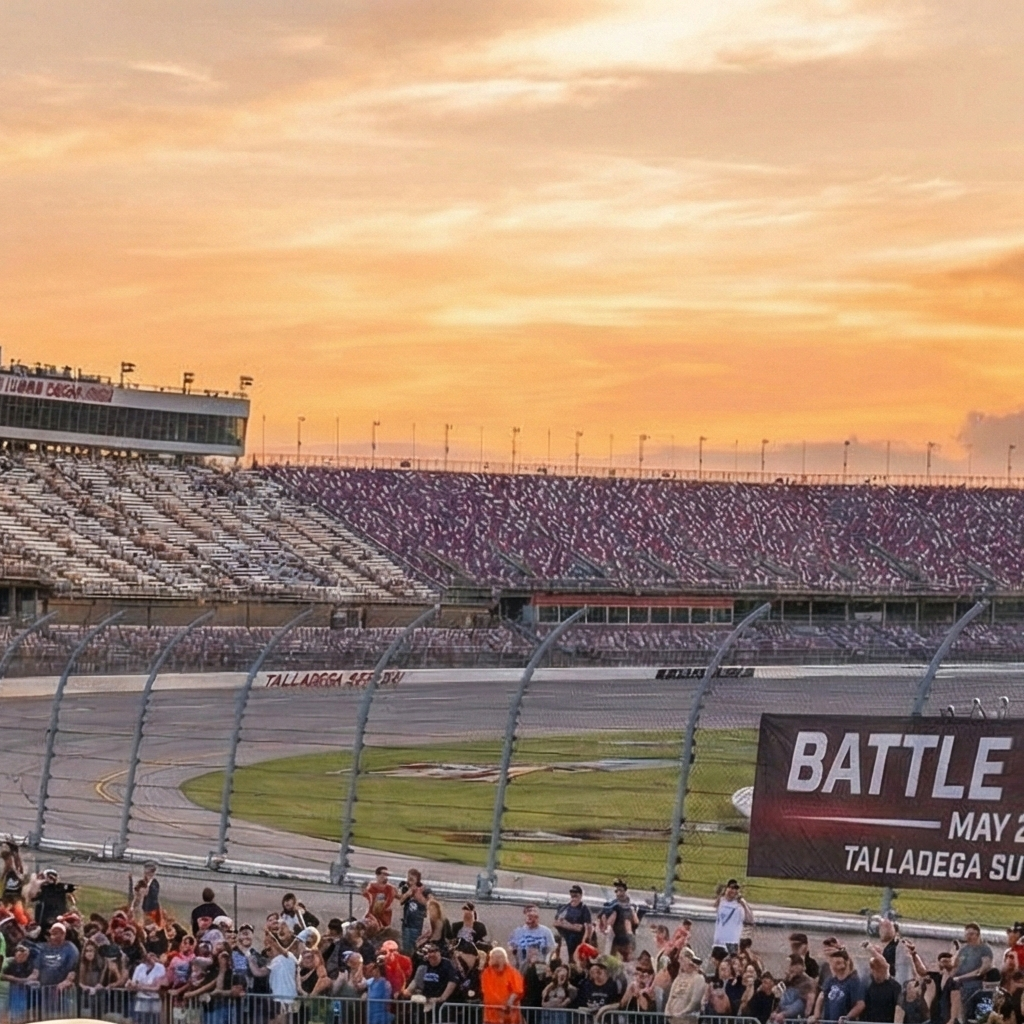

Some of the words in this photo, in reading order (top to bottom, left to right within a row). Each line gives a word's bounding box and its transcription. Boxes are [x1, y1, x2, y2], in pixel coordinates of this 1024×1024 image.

[787, 731, 1013, 801] BATTLE
[948, 811, 1012, 842] MAY
[844, 845, 982, 880] TALLADEGA
